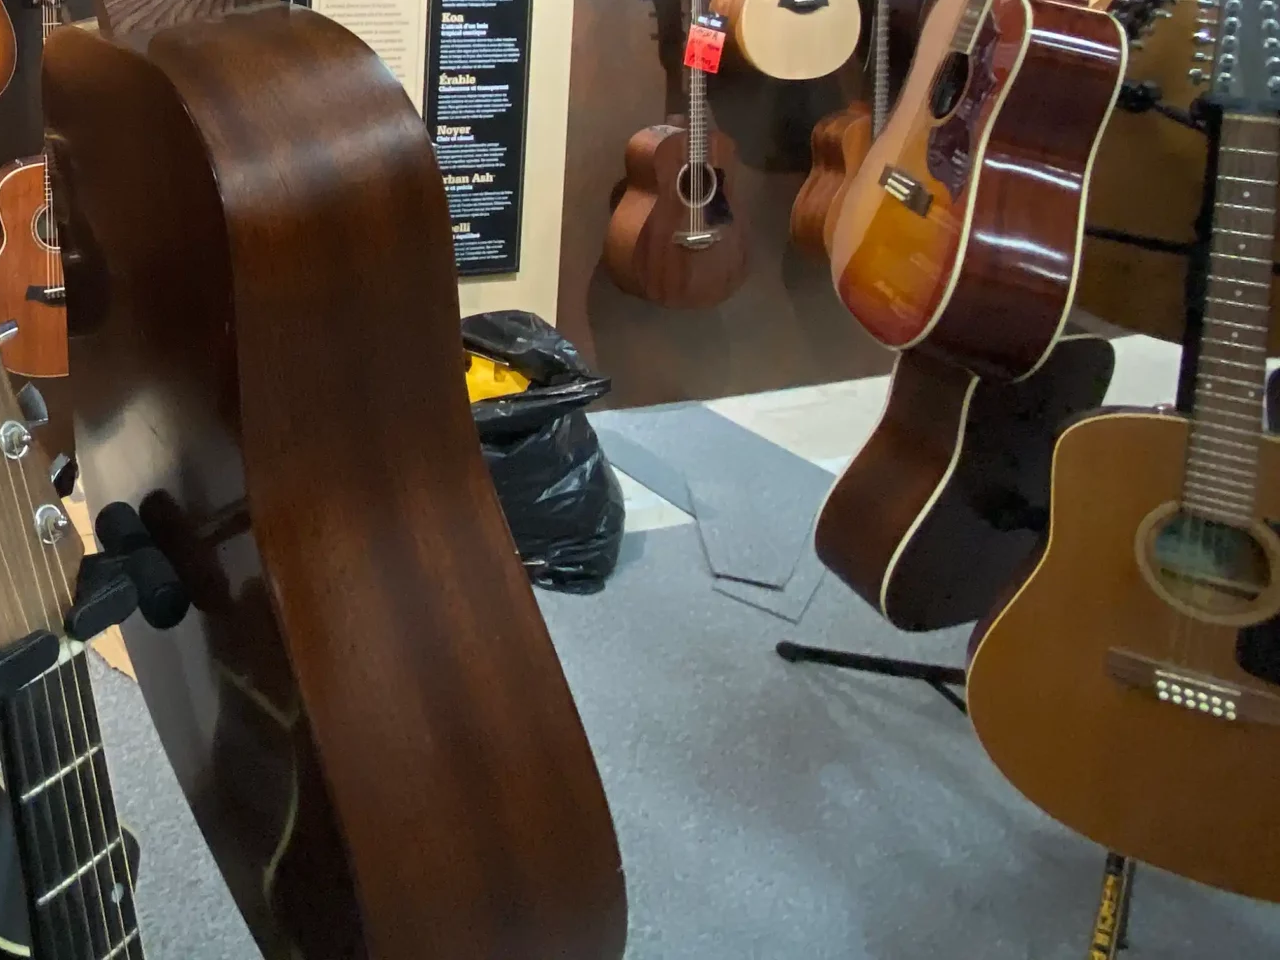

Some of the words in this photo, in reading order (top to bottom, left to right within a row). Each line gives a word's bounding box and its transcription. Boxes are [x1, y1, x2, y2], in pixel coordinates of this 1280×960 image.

[441, 12, 465, 23] Koa
[438, 73, 477, 85] Érable
[437, 125, 472, 136] Noyer
[442, 174, 470, 185] rban
[472, 172, 494, 183] Ash
[452, 222, 471, 233] elli
